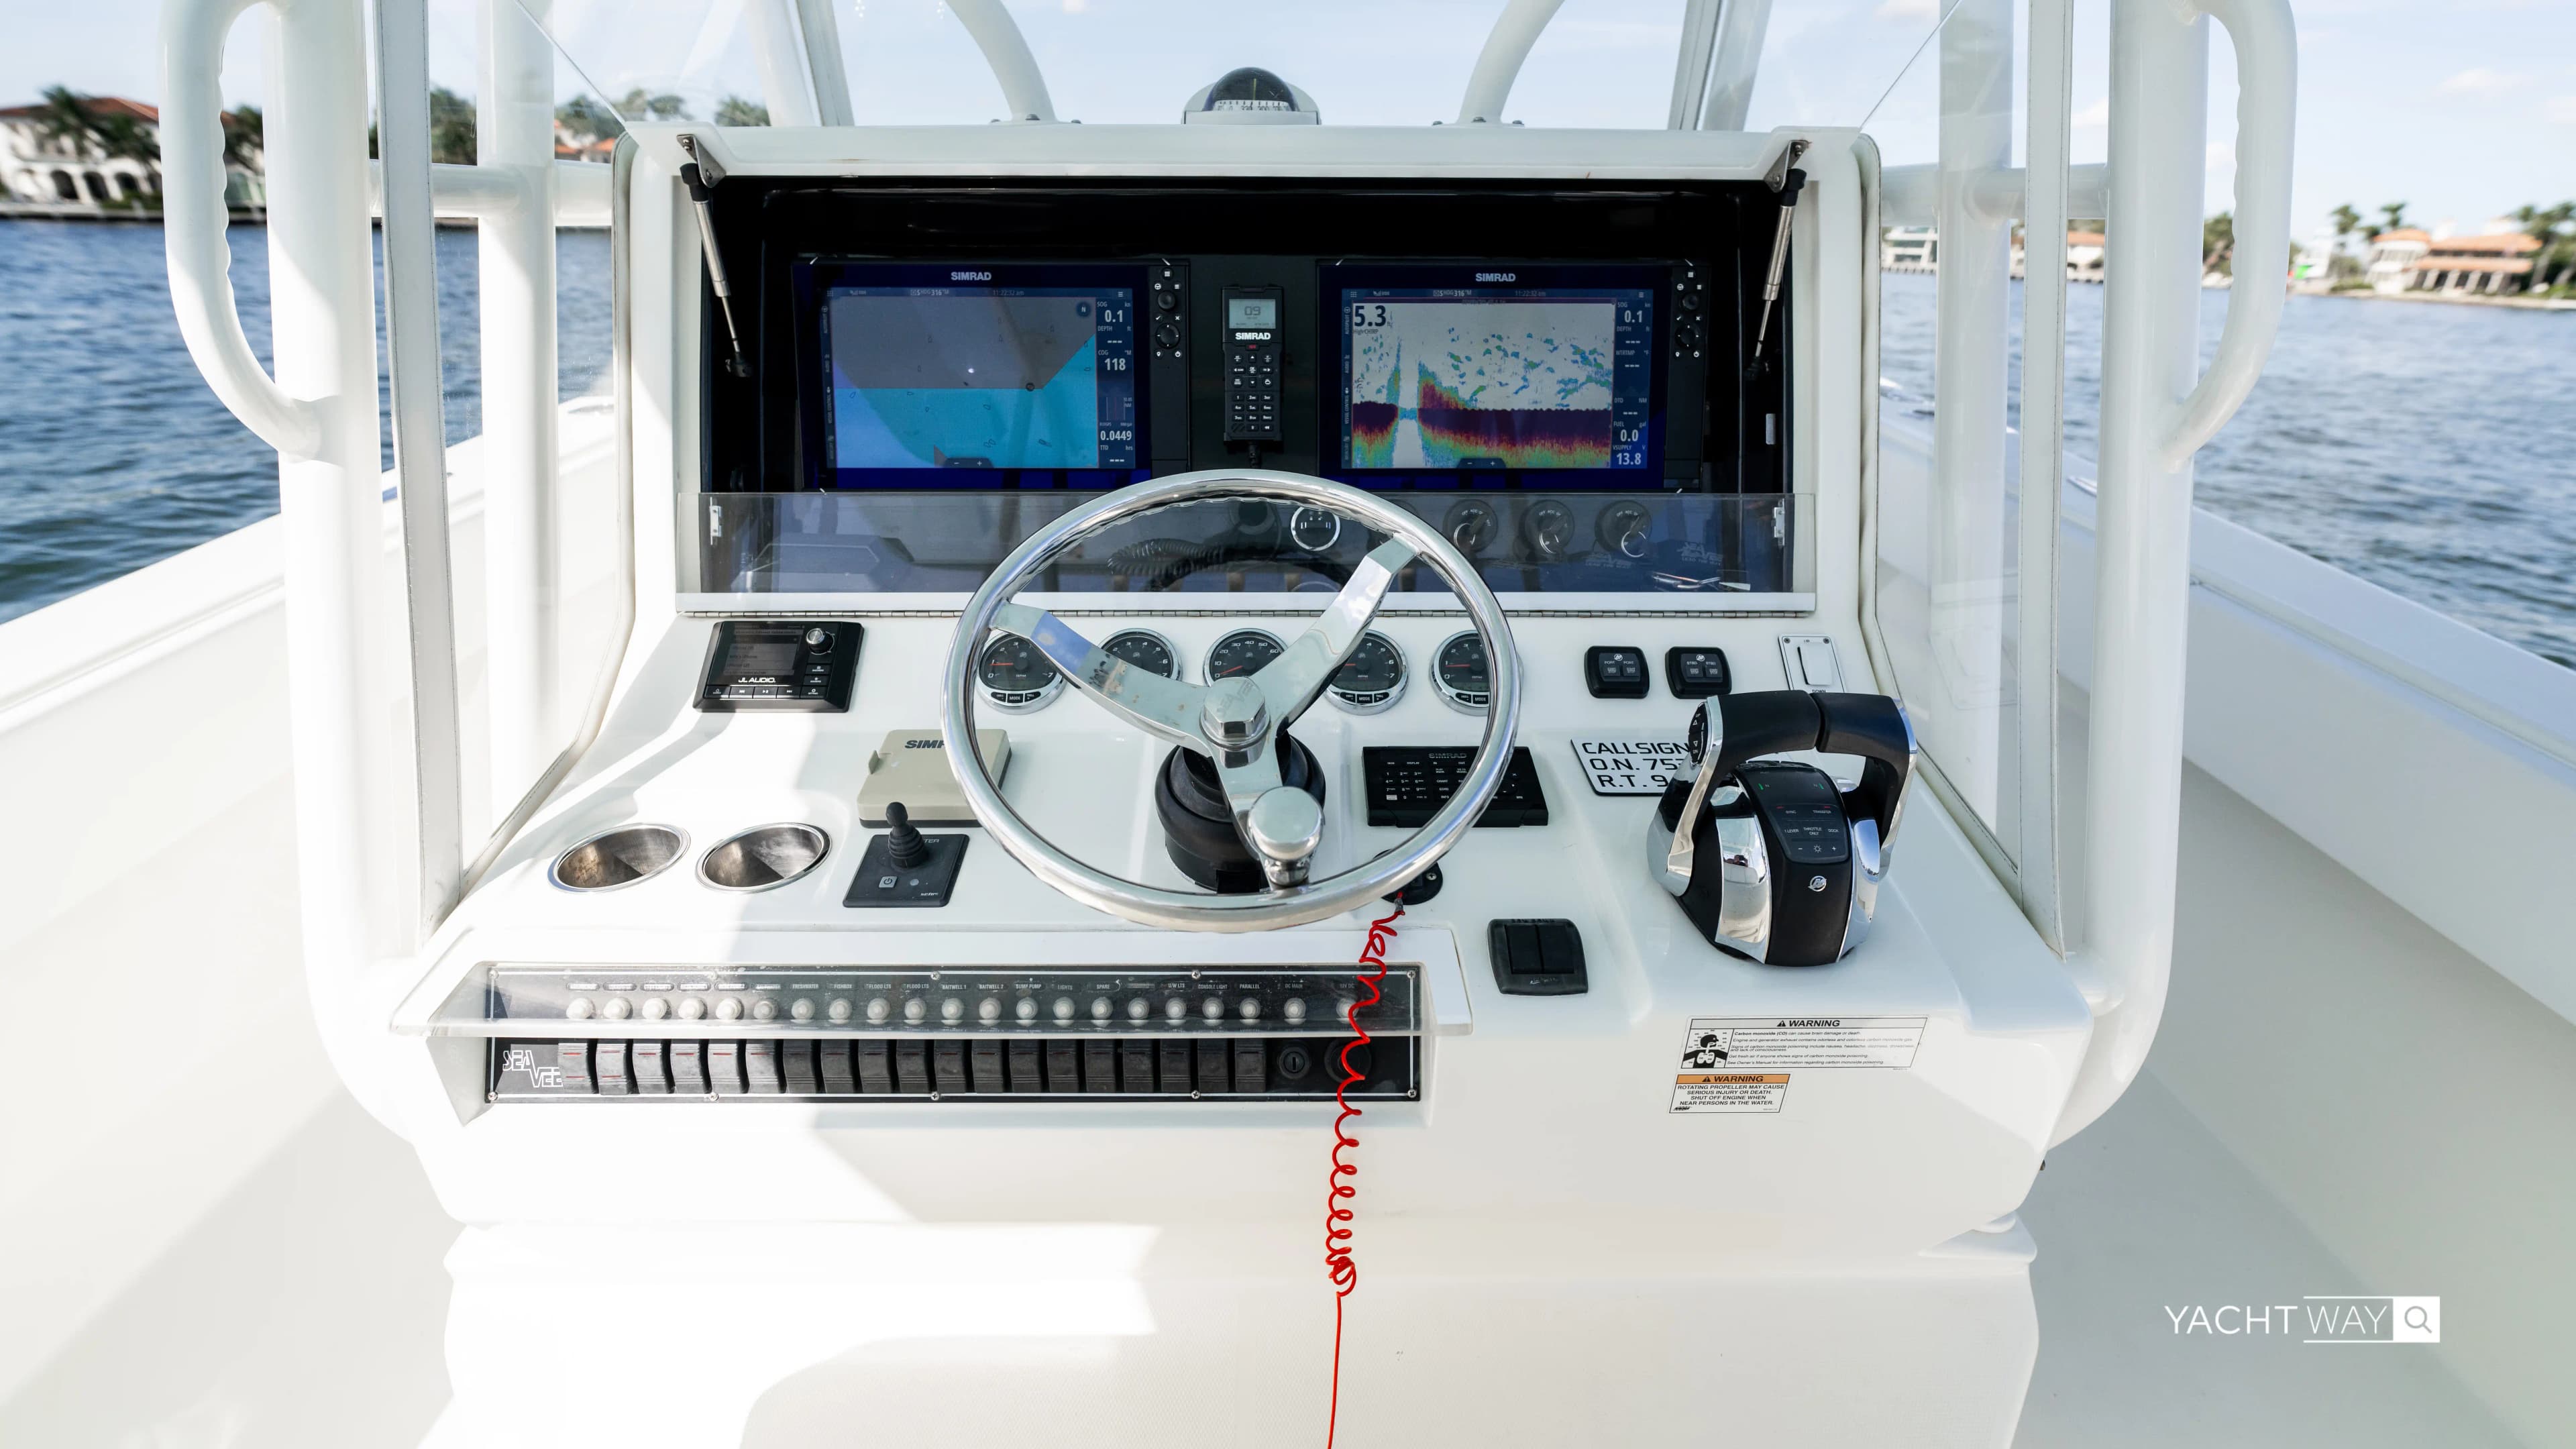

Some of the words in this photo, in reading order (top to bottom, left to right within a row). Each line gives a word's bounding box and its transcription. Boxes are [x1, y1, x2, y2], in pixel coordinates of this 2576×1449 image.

[951, 272, 991, 280] SIMRAD
[1476, 273, 1516, 282] SIMRAD
[1105, 310, 1123, 323] 0.1
[1244, 306, 1260, 315] 09
[1354, 305, 1386, 327] 5.3
[1624, 310, 1643, 323] 0.1
[1235, 332, 1271, 340] SIMRAD
[1105, 358, 1126, 370] 118
[1100, 431, 1132, 441] 0.0449
[1620, 429, 1639, 442] 0.0
[1616, 452, 1642, 465] 13.8
[1582, 742, 1690, 755] CALLSIGN
[1589, 758, 1640, 771] O.N.
[502, 1049, 532, 1071] SEA
